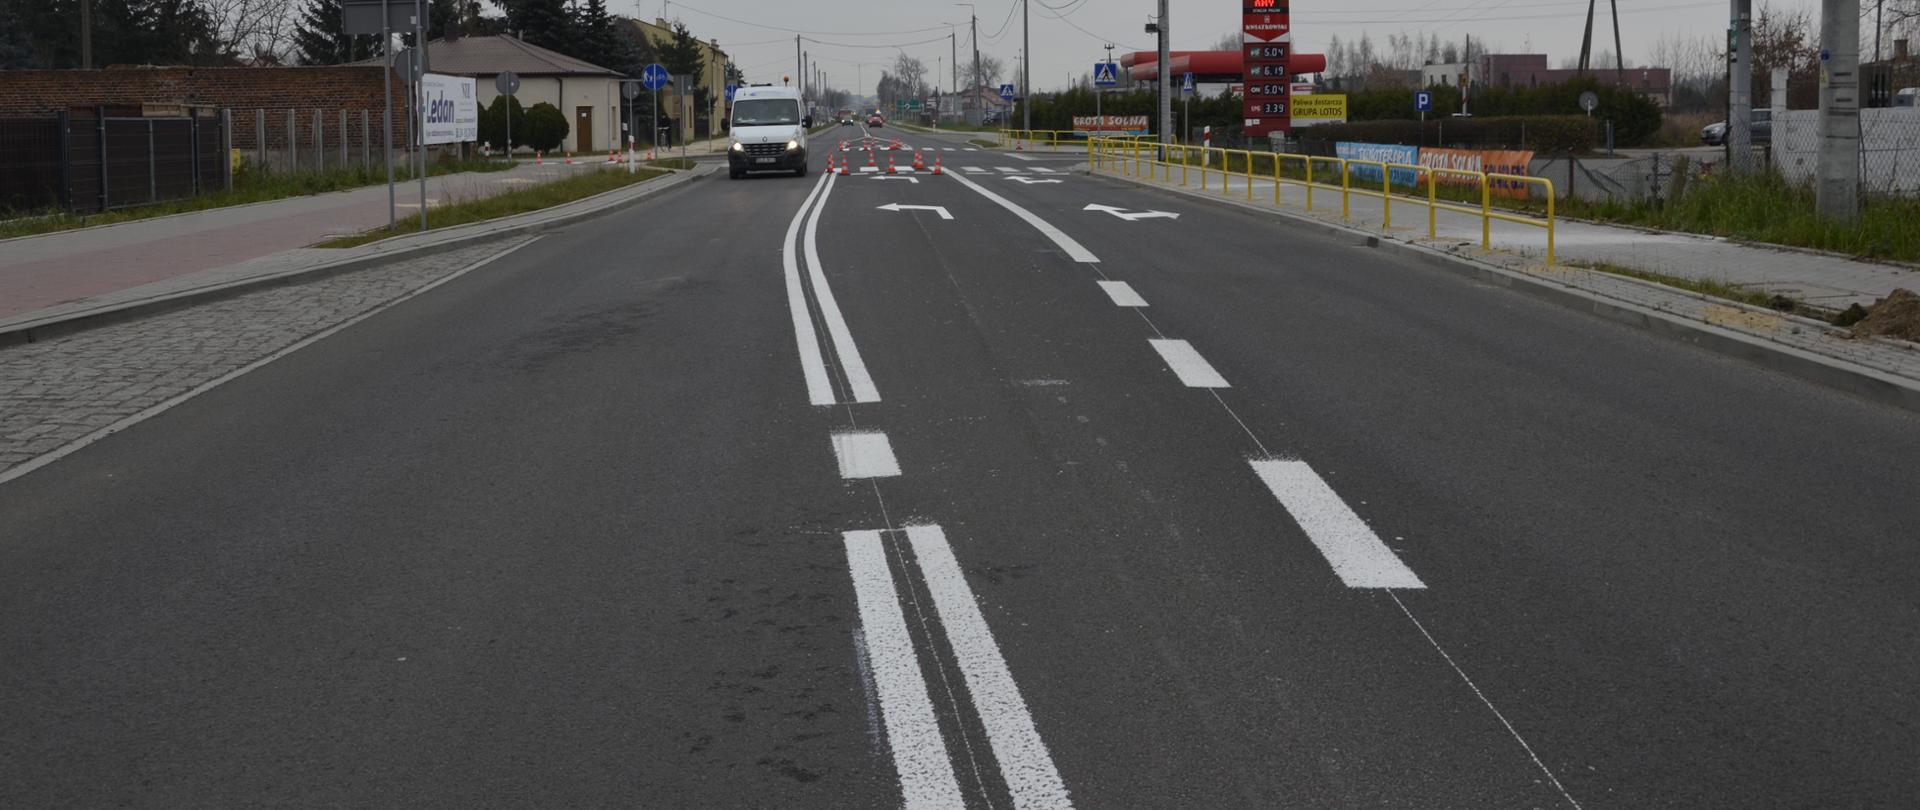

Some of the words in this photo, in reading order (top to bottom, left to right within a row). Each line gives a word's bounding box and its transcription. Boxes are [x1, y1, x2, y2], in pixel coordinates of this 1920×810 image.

[426, 90, 455, 124] Ledan
[1419, 93, 1429, 109] P
[1293, 107, 1318, 116] GRUPA
[1319, 107, 1343, 116] LOTOS
[1107, 115, 1147, 126] SOLNA
